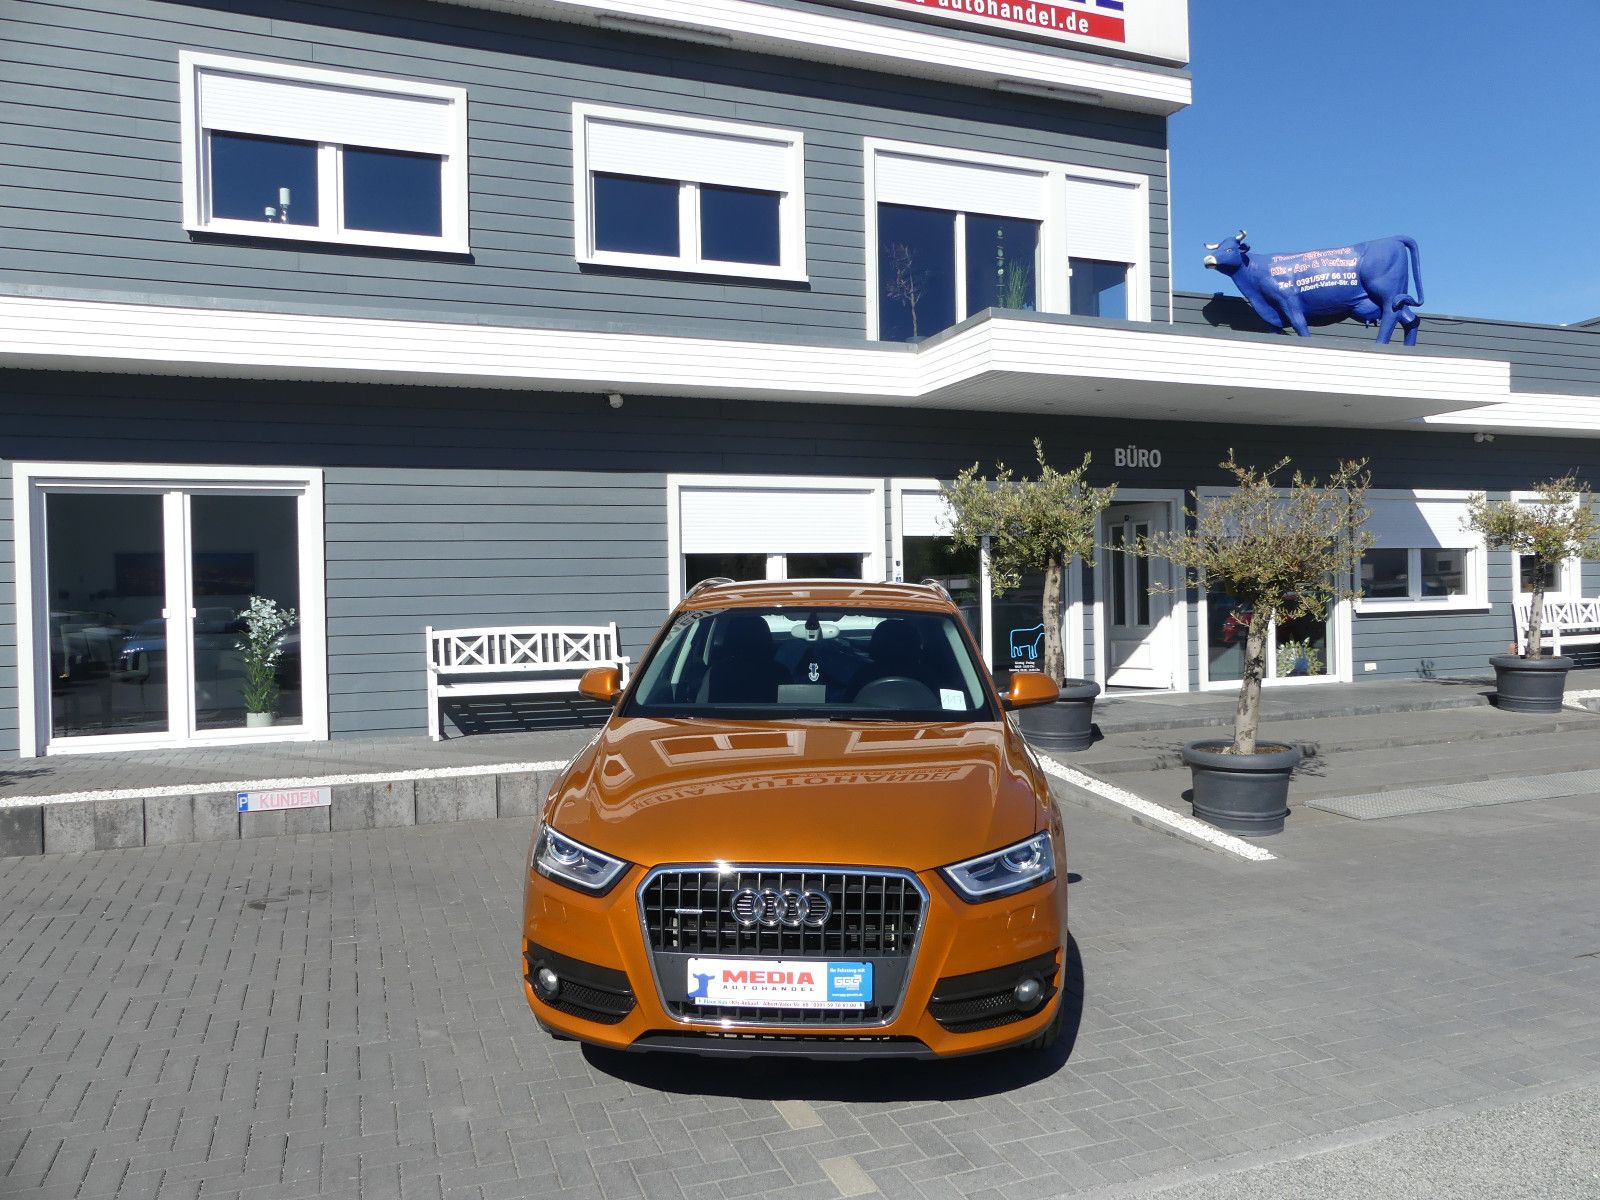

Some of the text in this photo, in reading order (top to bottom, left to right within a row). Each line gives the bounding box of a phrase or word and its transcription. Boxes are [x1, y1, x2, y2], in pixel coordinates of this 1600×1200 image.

[1296, 273, 1329, 287] 0391/597
[1343, 272, 1356, 280] 100
[1114, 444, 1162, 468] BÜRO
[259, 790, 320, 809] KUNDEN
[722, 969, 815, 985] MEDIA
[722, 984, 815, 992] AUTOHANDEL
